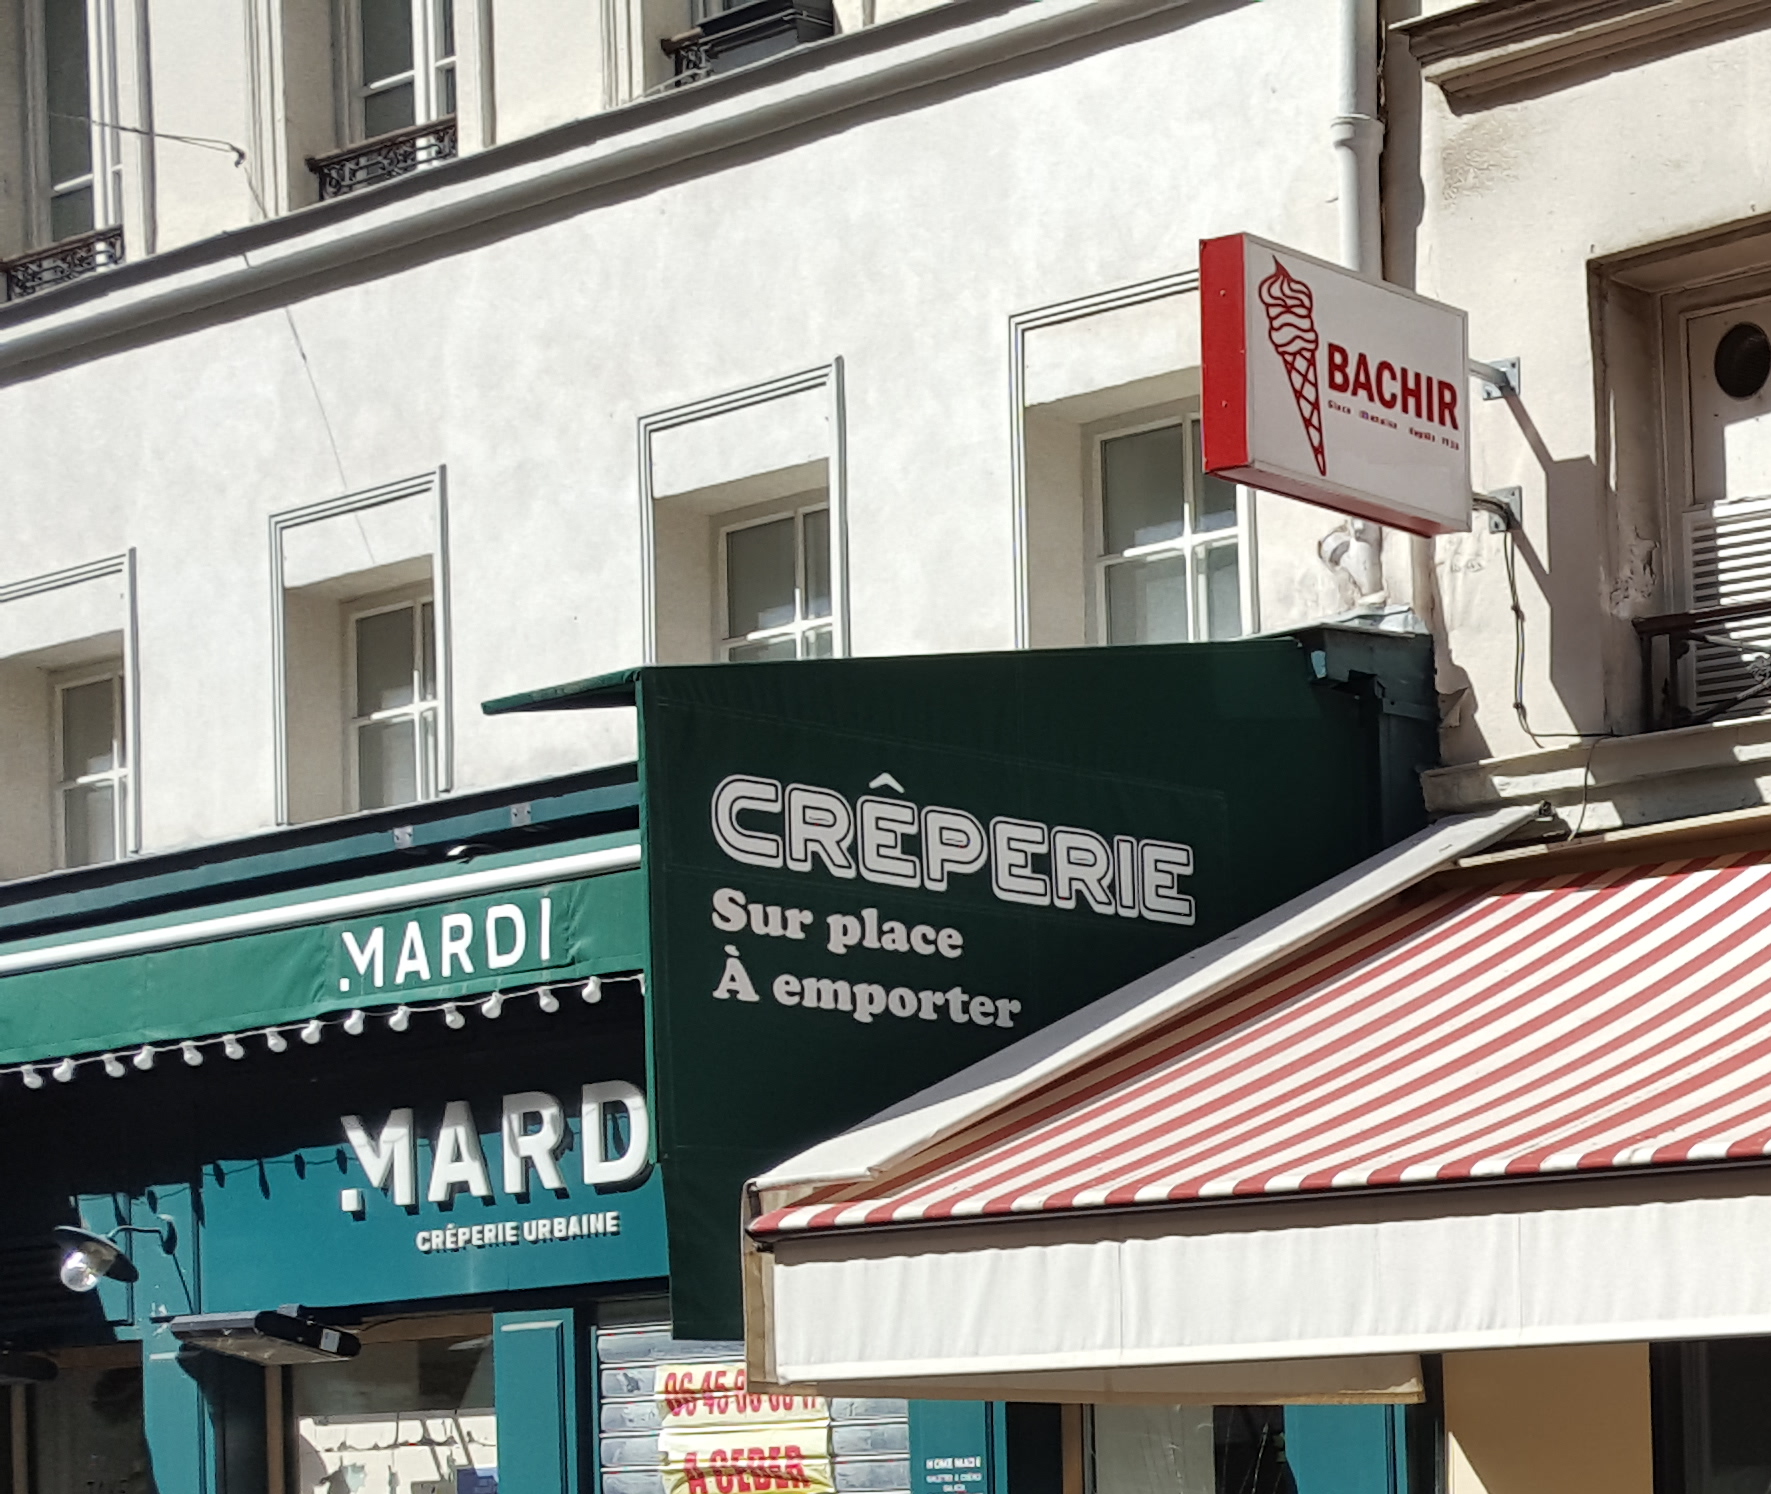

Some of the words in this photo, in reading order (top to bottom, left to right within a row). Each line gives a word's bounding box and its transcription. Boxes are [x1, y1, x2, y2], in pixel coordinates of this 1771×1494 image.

[1328, 342, 1459, 430] BACHIR
[711, 772, 1196, 926] CRÊPERIE
[339, 898, 552, 992] MARDI
[712, 888, 813, 940] Sur
[826, 908, 964, 959] place
[713, 945, 760, 1003] À
[772, 972, 1022, 1029] emporter
[340, 1080, 650, 1212] MARD
[523, 1211, 620, 1242] URBAINE
[665, 1372, 697, 1416] 06
[684, 1451, 708, 1494] A
[710, 1445, 811, 1494] CEDER
